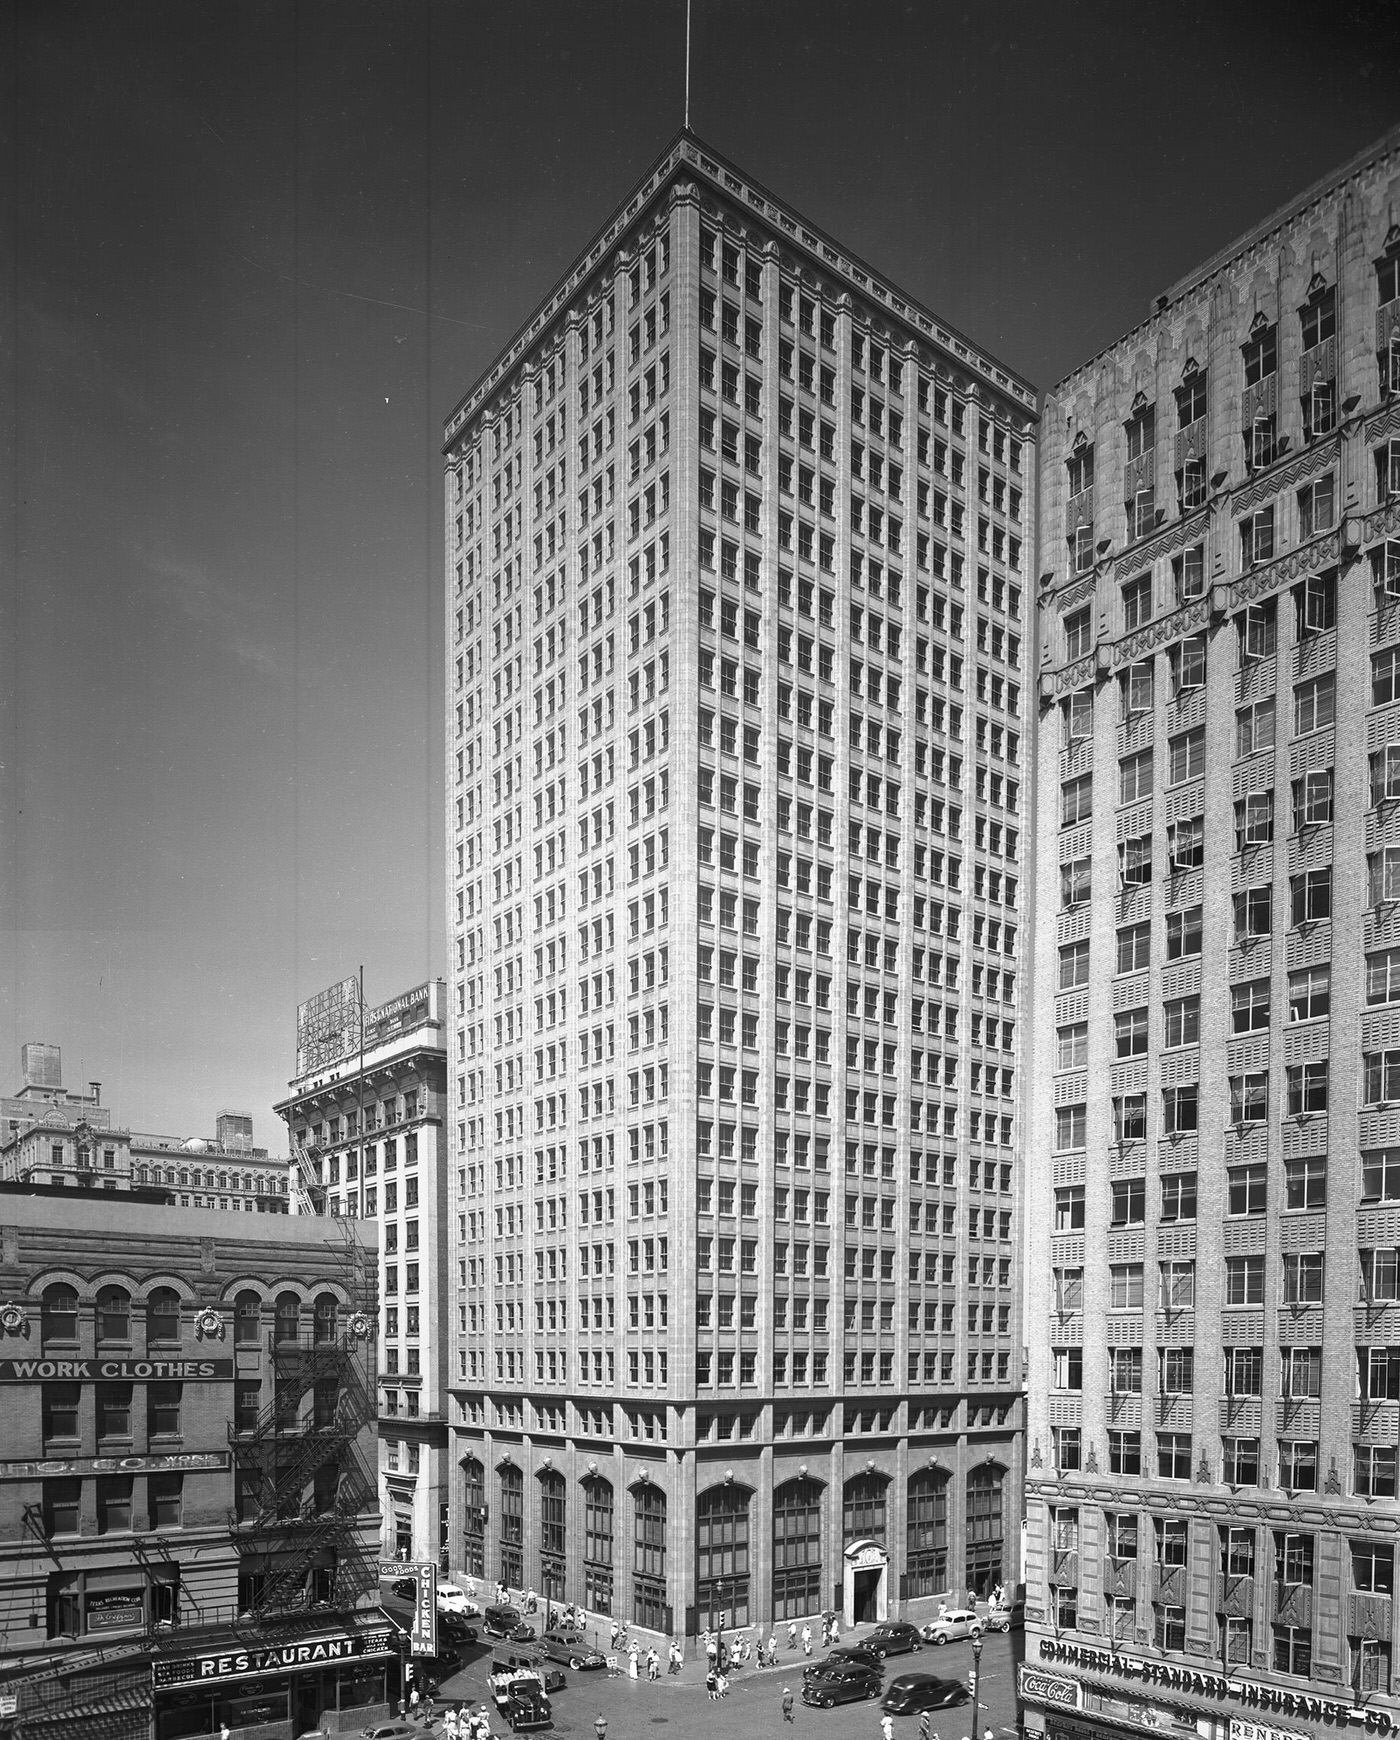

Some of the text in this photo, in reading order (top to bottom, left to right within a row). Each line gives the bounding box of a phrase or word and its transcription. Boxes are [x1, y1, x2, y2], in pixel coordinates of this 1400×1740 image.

[380, 996, 410, 1019] NATIONAL
[410, 987, 428, 1005] BANK
[12, 1361, 91, 1377] WORK
[100, 1362, 215, 1377] CLOTHES
[381, 1565, 418, 1575] GOOD FOODS
[420, 1566, 431, 1639] CHICKEN
[201, 1640, 356, 1677] RESTAURANT
[413, 1642, 434, 1652] BAR
[1241, 1683, 1348, 1724] INSURANCE
